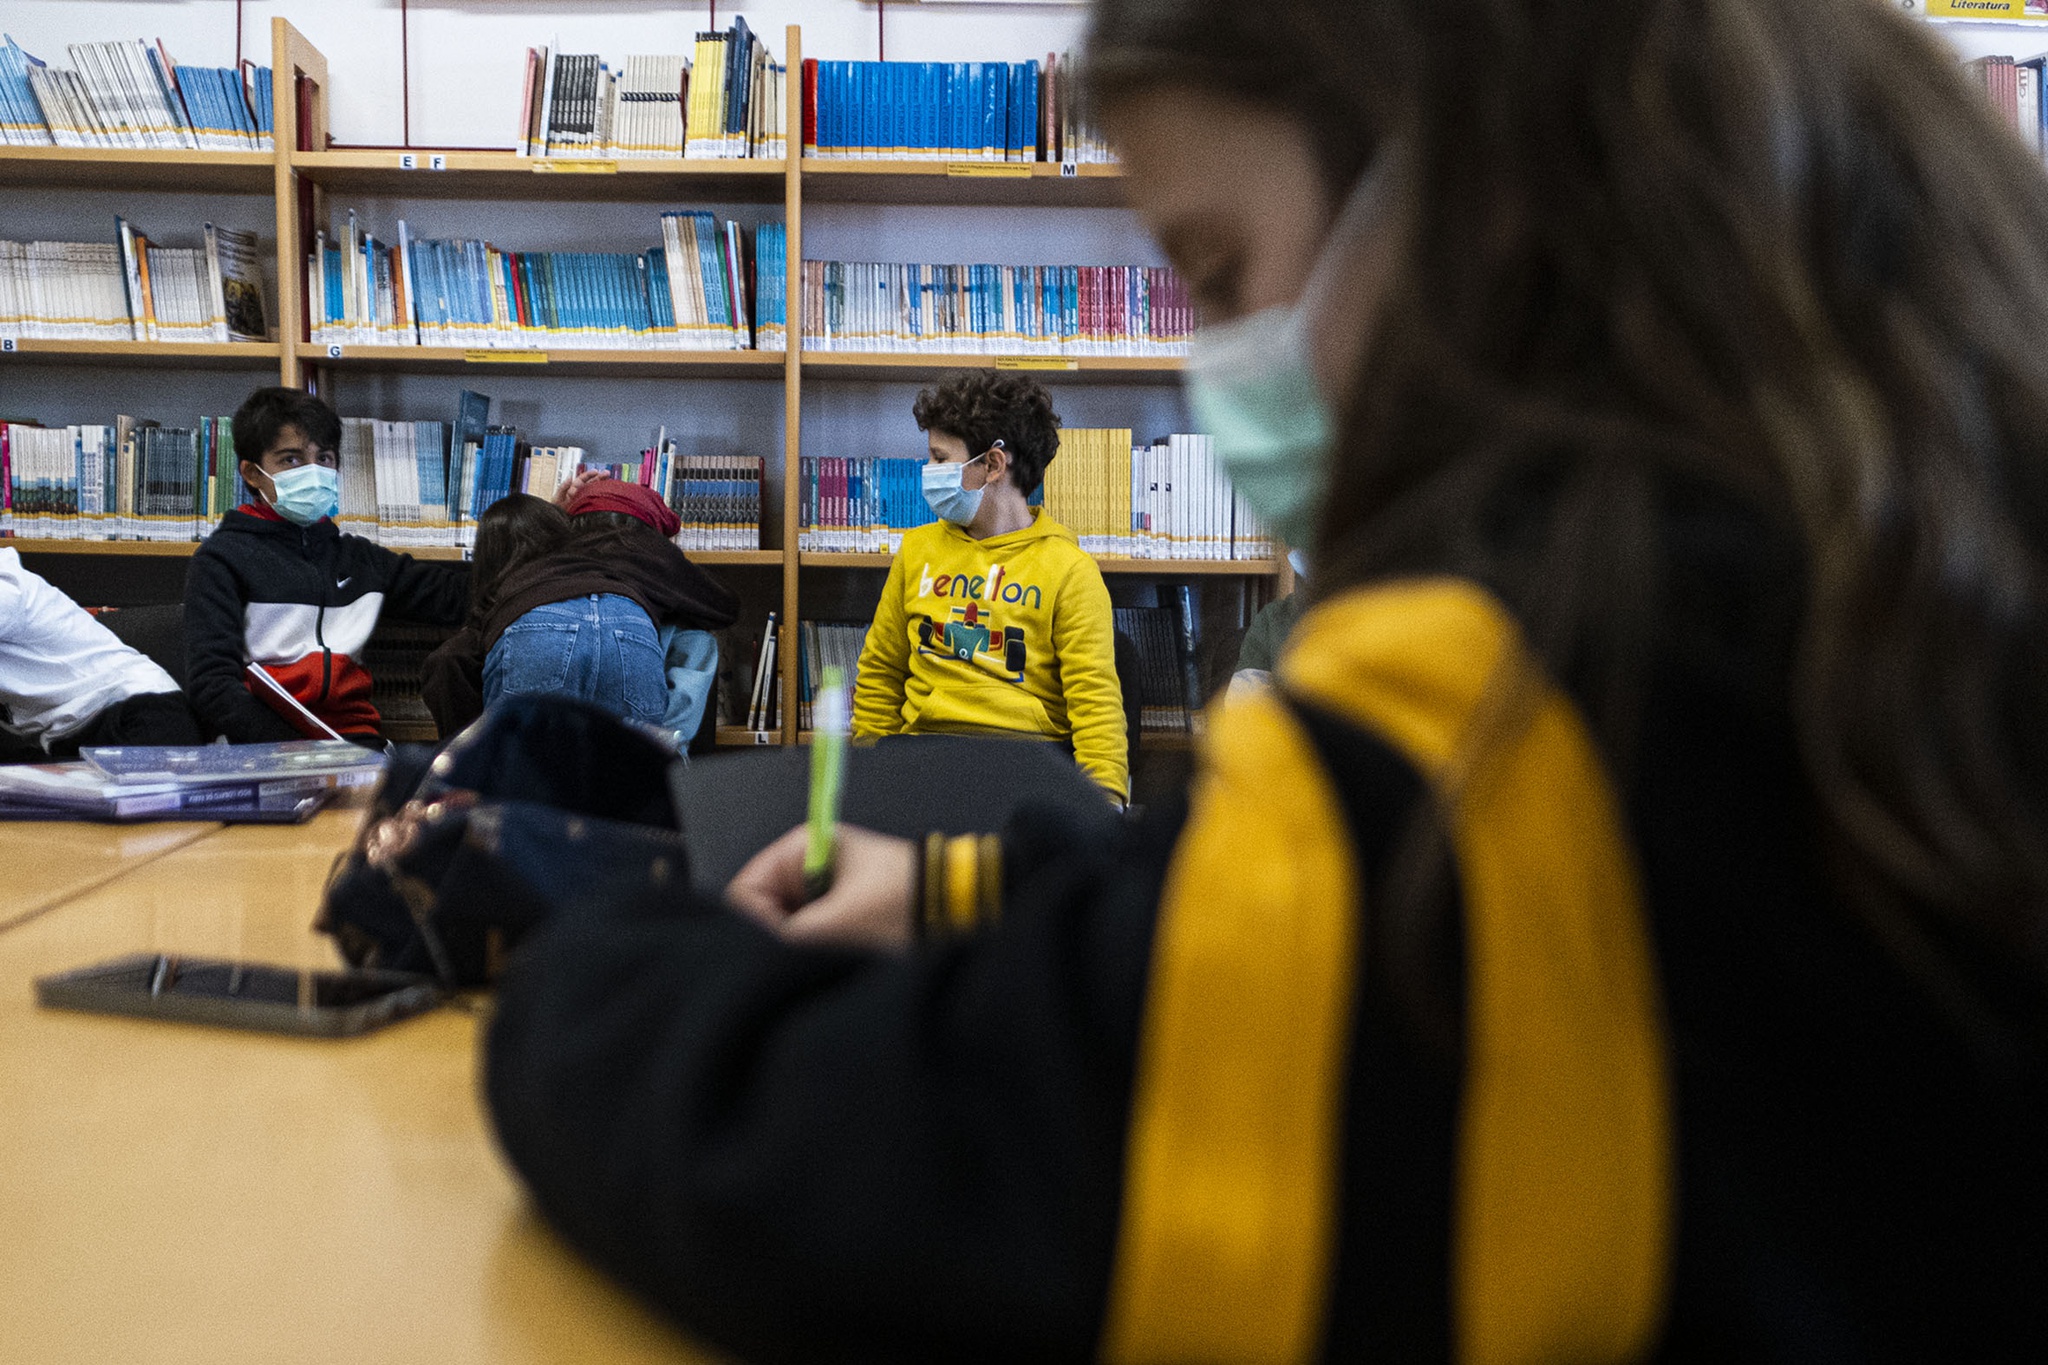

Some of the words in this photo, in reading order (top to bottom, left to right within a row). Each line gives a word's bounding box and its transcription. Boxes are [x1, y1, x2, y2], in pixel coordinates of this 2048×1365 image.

[1950, 0, 2011, 11] Literatura
[403, 156, 412, 167] E
[433, 157, 442, 169] F
[1062, 164, 1076, 175] M
[3, 339, 14, 350] B
[330, 345, 341, 357] G
[757, 732, 767, 744] L
